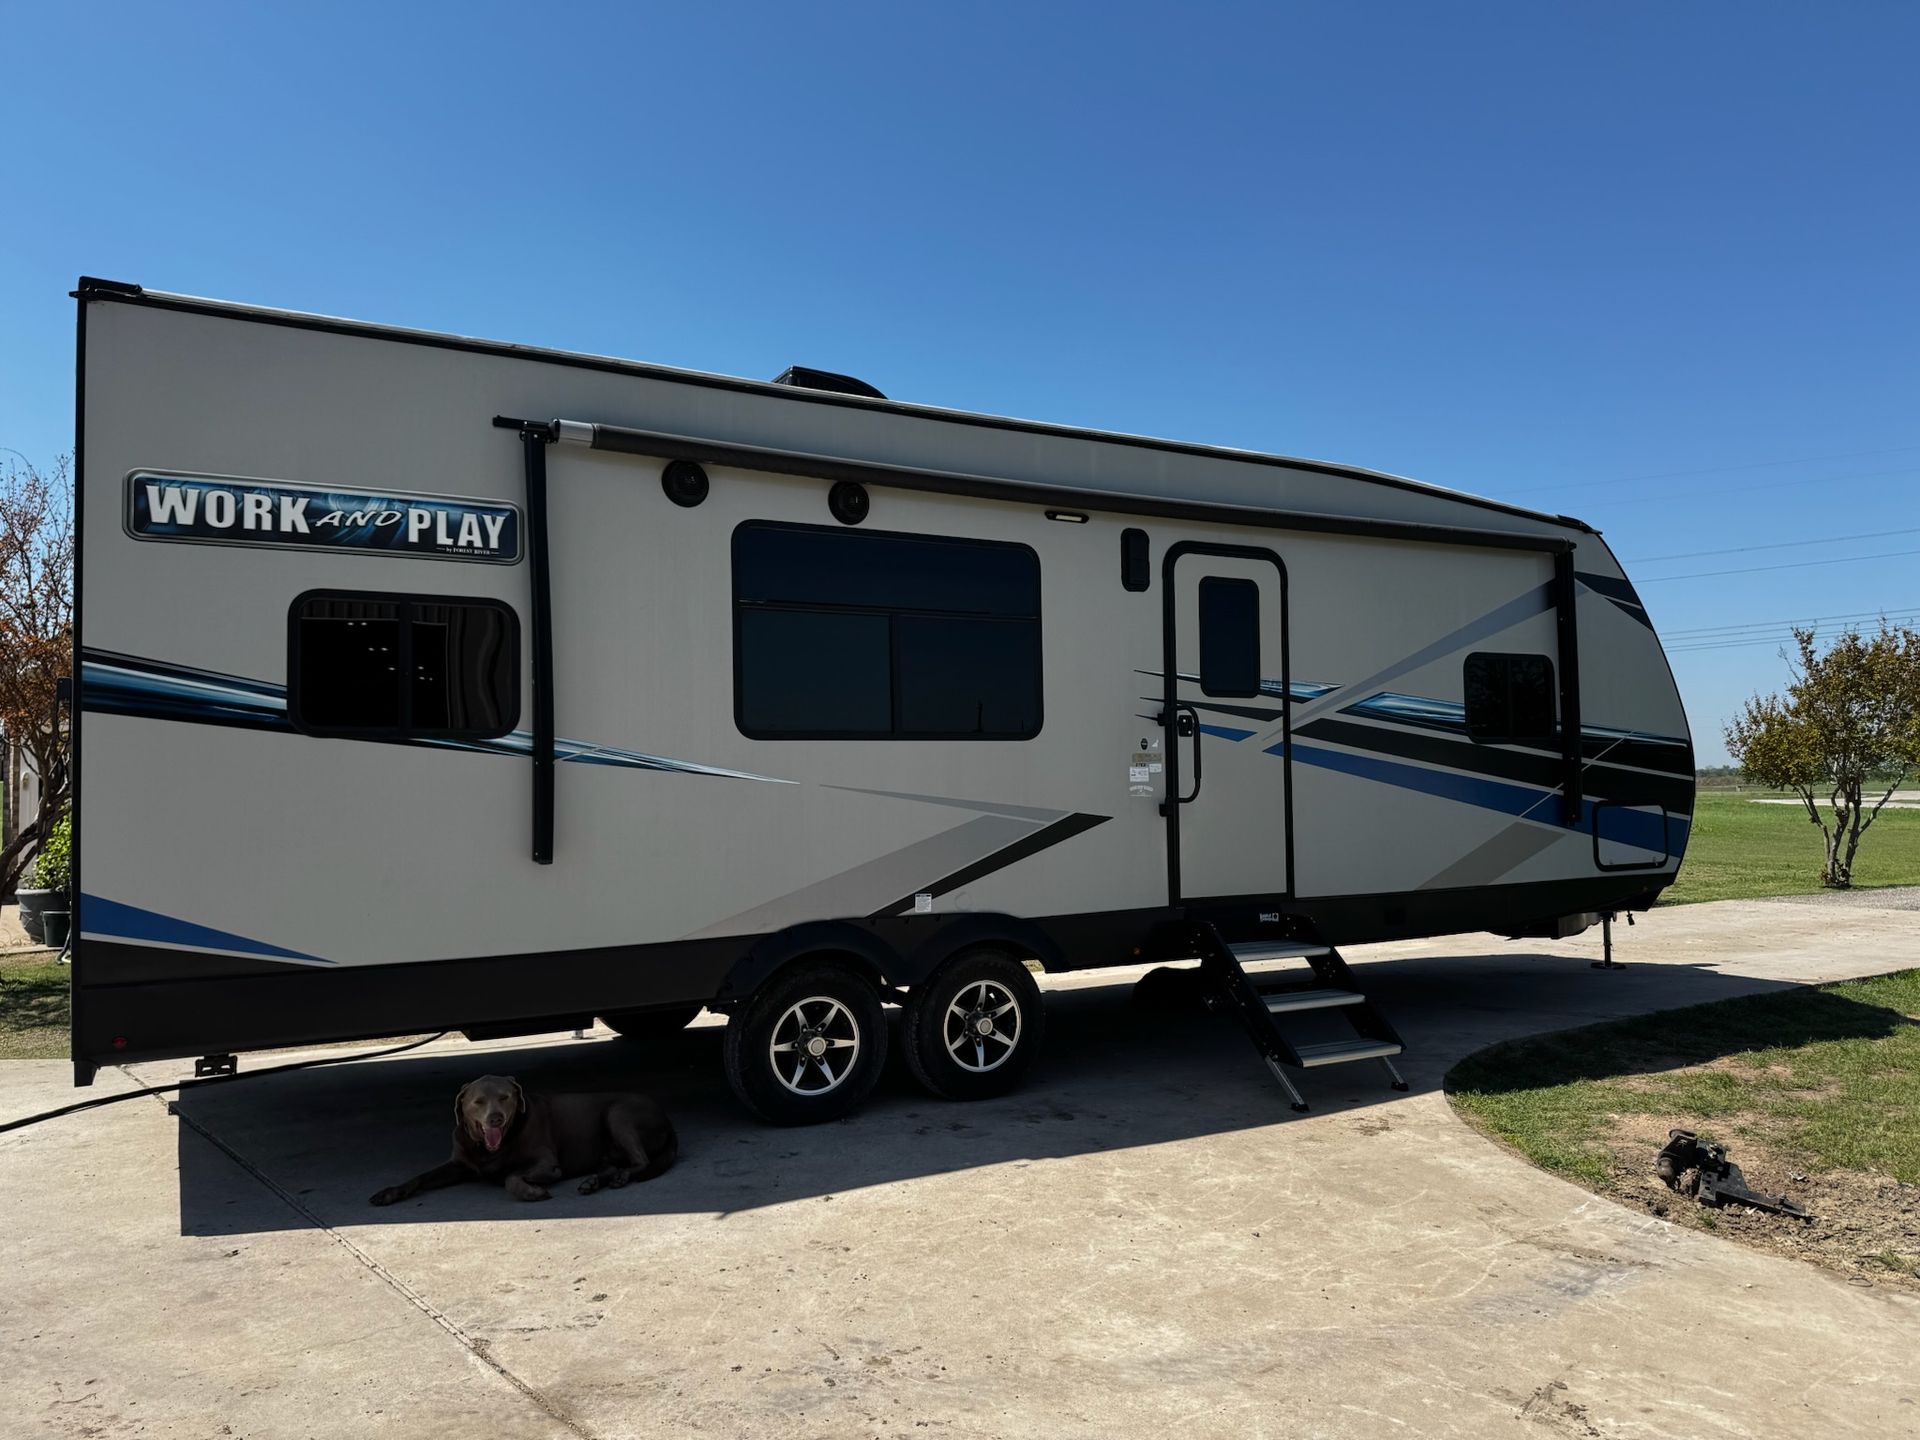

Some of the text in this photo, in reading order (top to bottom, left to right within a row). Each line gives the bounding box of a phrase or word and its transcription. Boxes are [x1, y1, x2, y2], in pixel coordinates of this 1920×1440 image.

[145, 485, 506, 549] WORK AND PLAY
